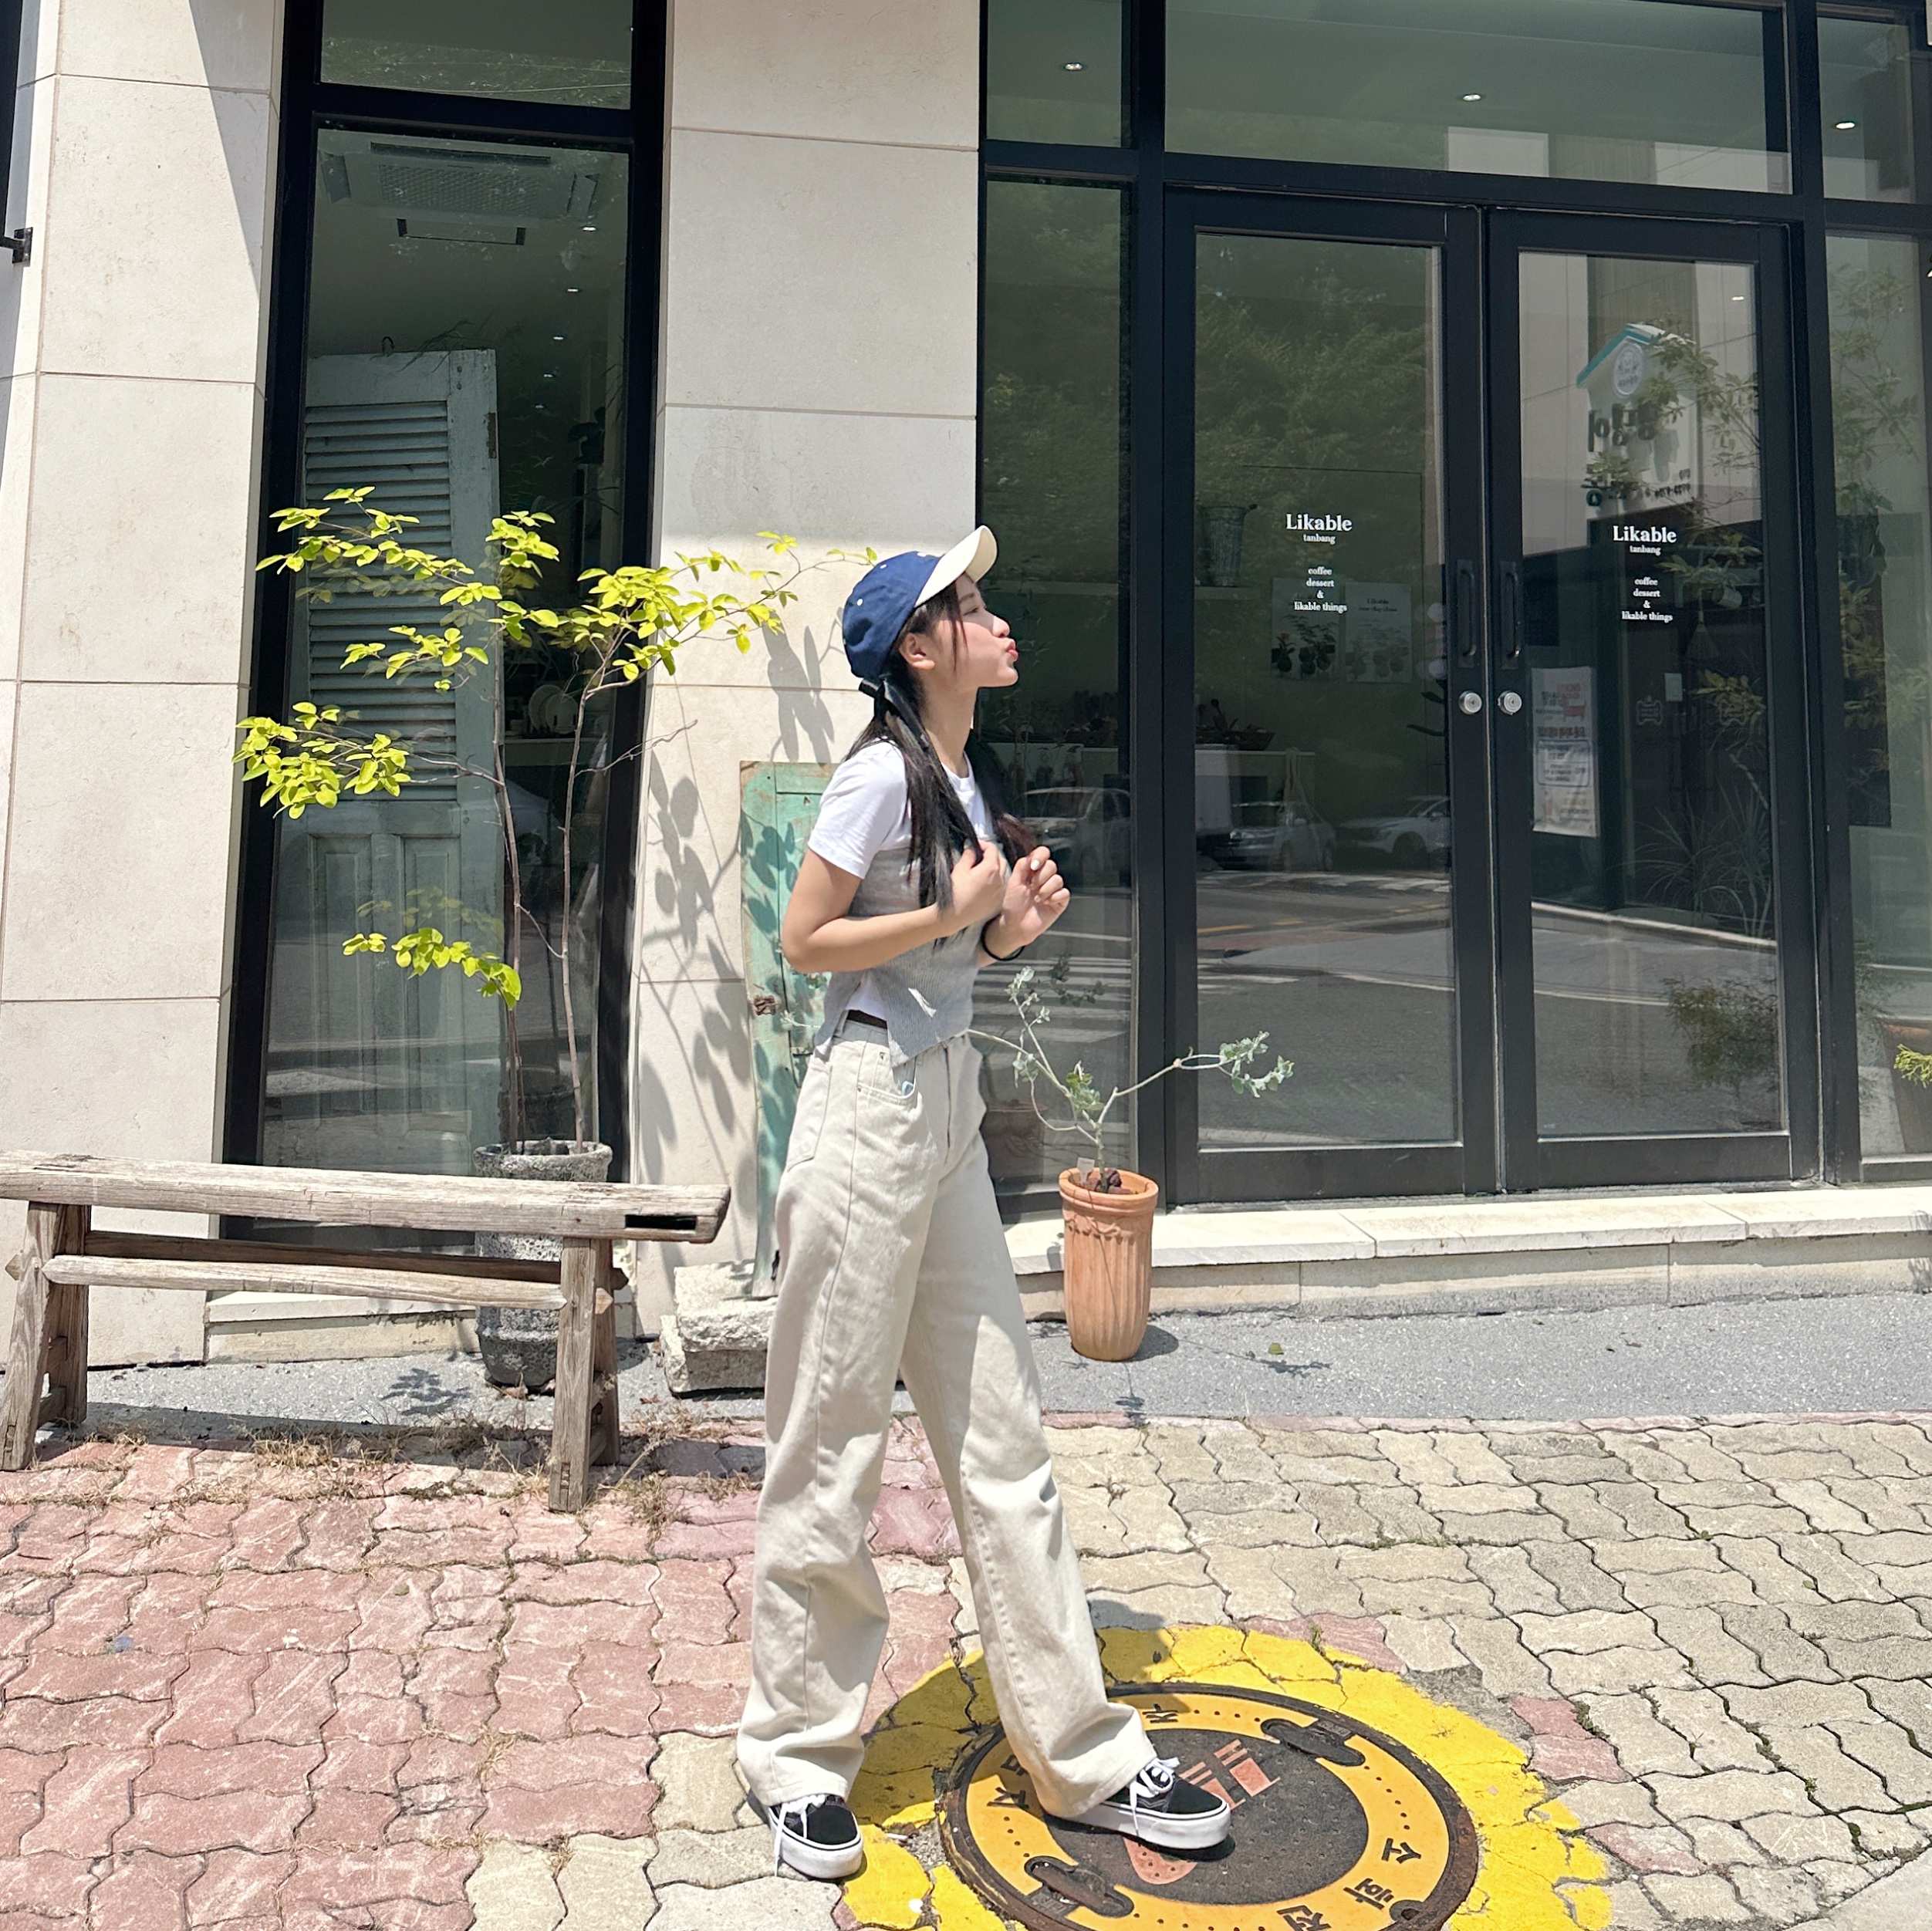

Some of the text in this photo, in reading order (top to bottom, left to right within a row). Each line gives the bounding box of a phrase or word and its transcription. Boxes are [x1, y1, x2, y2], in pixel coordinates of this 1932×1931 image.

[1285, 513, 1353, 532] Likable
[1302, 533, 1336, 545] tanbang
[1612, 525, 1677, 543] Likable
[1629, 545, 1662, 556] tanbang
[1308, 565, 1332, 576] coffee
[1305, 577, 1335, 587] dessert
[1634, 576, 1658, 586] coffee
[1316, 589, 1325, 599] &
[1633, 588, 1661, 598] dessert
[1294, 601, 1348, 614] likable things
[1643, 599, 1651, 609] &
[1621, 610, 1674, 623] likable things
[1276, 1837, 1422, 1931] 소화전
